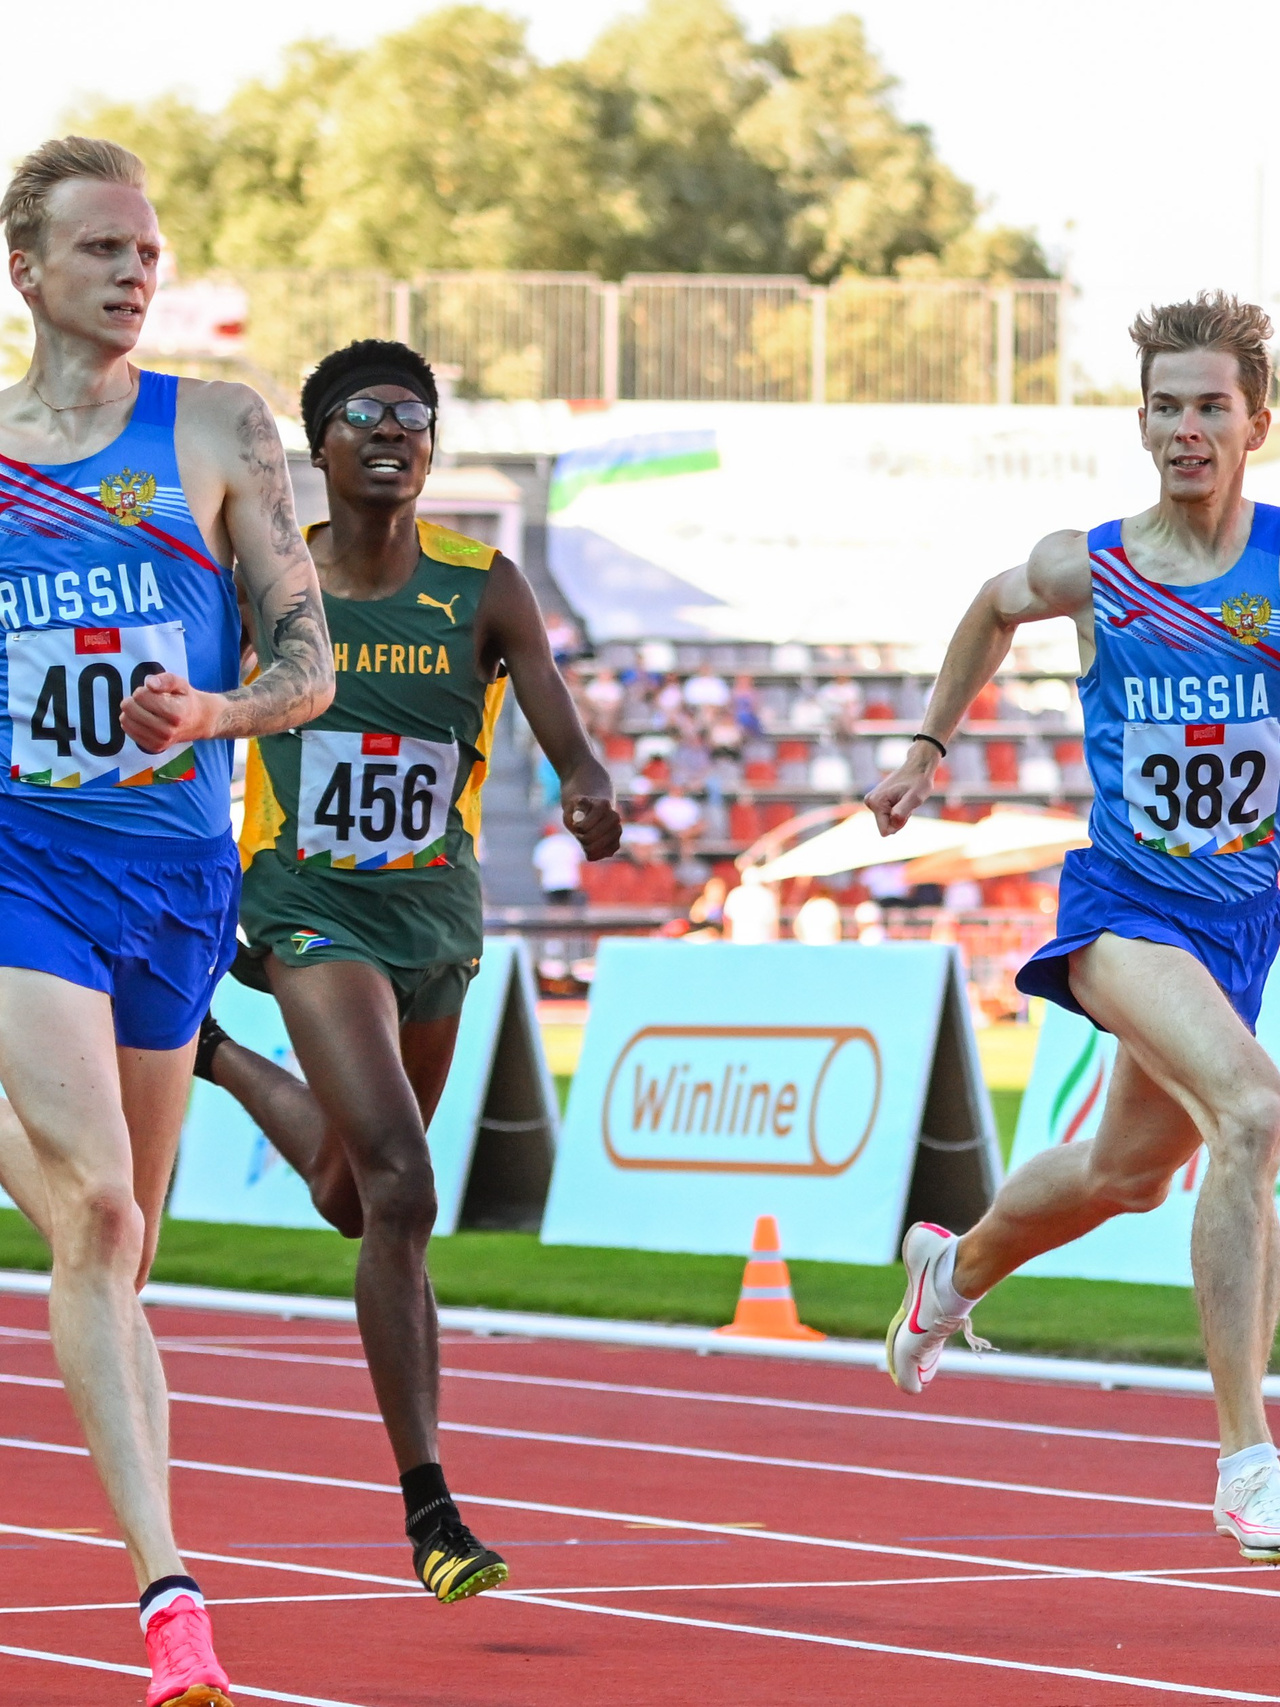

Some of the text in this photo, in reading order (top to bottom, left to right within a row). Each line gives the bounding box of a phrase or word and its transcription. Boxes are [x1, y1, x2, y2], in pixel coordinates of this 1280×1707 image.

[0, 562, 164, 630] RUSSIA
[334, 643, 451, 675] H AFRICA
[1124, 673, 1270, 721] RUSSIA
[314, 762, 436, 842] 456
[1140, 750, 1266, 831] 382
[628, 1061, 799, 1139] Winline
